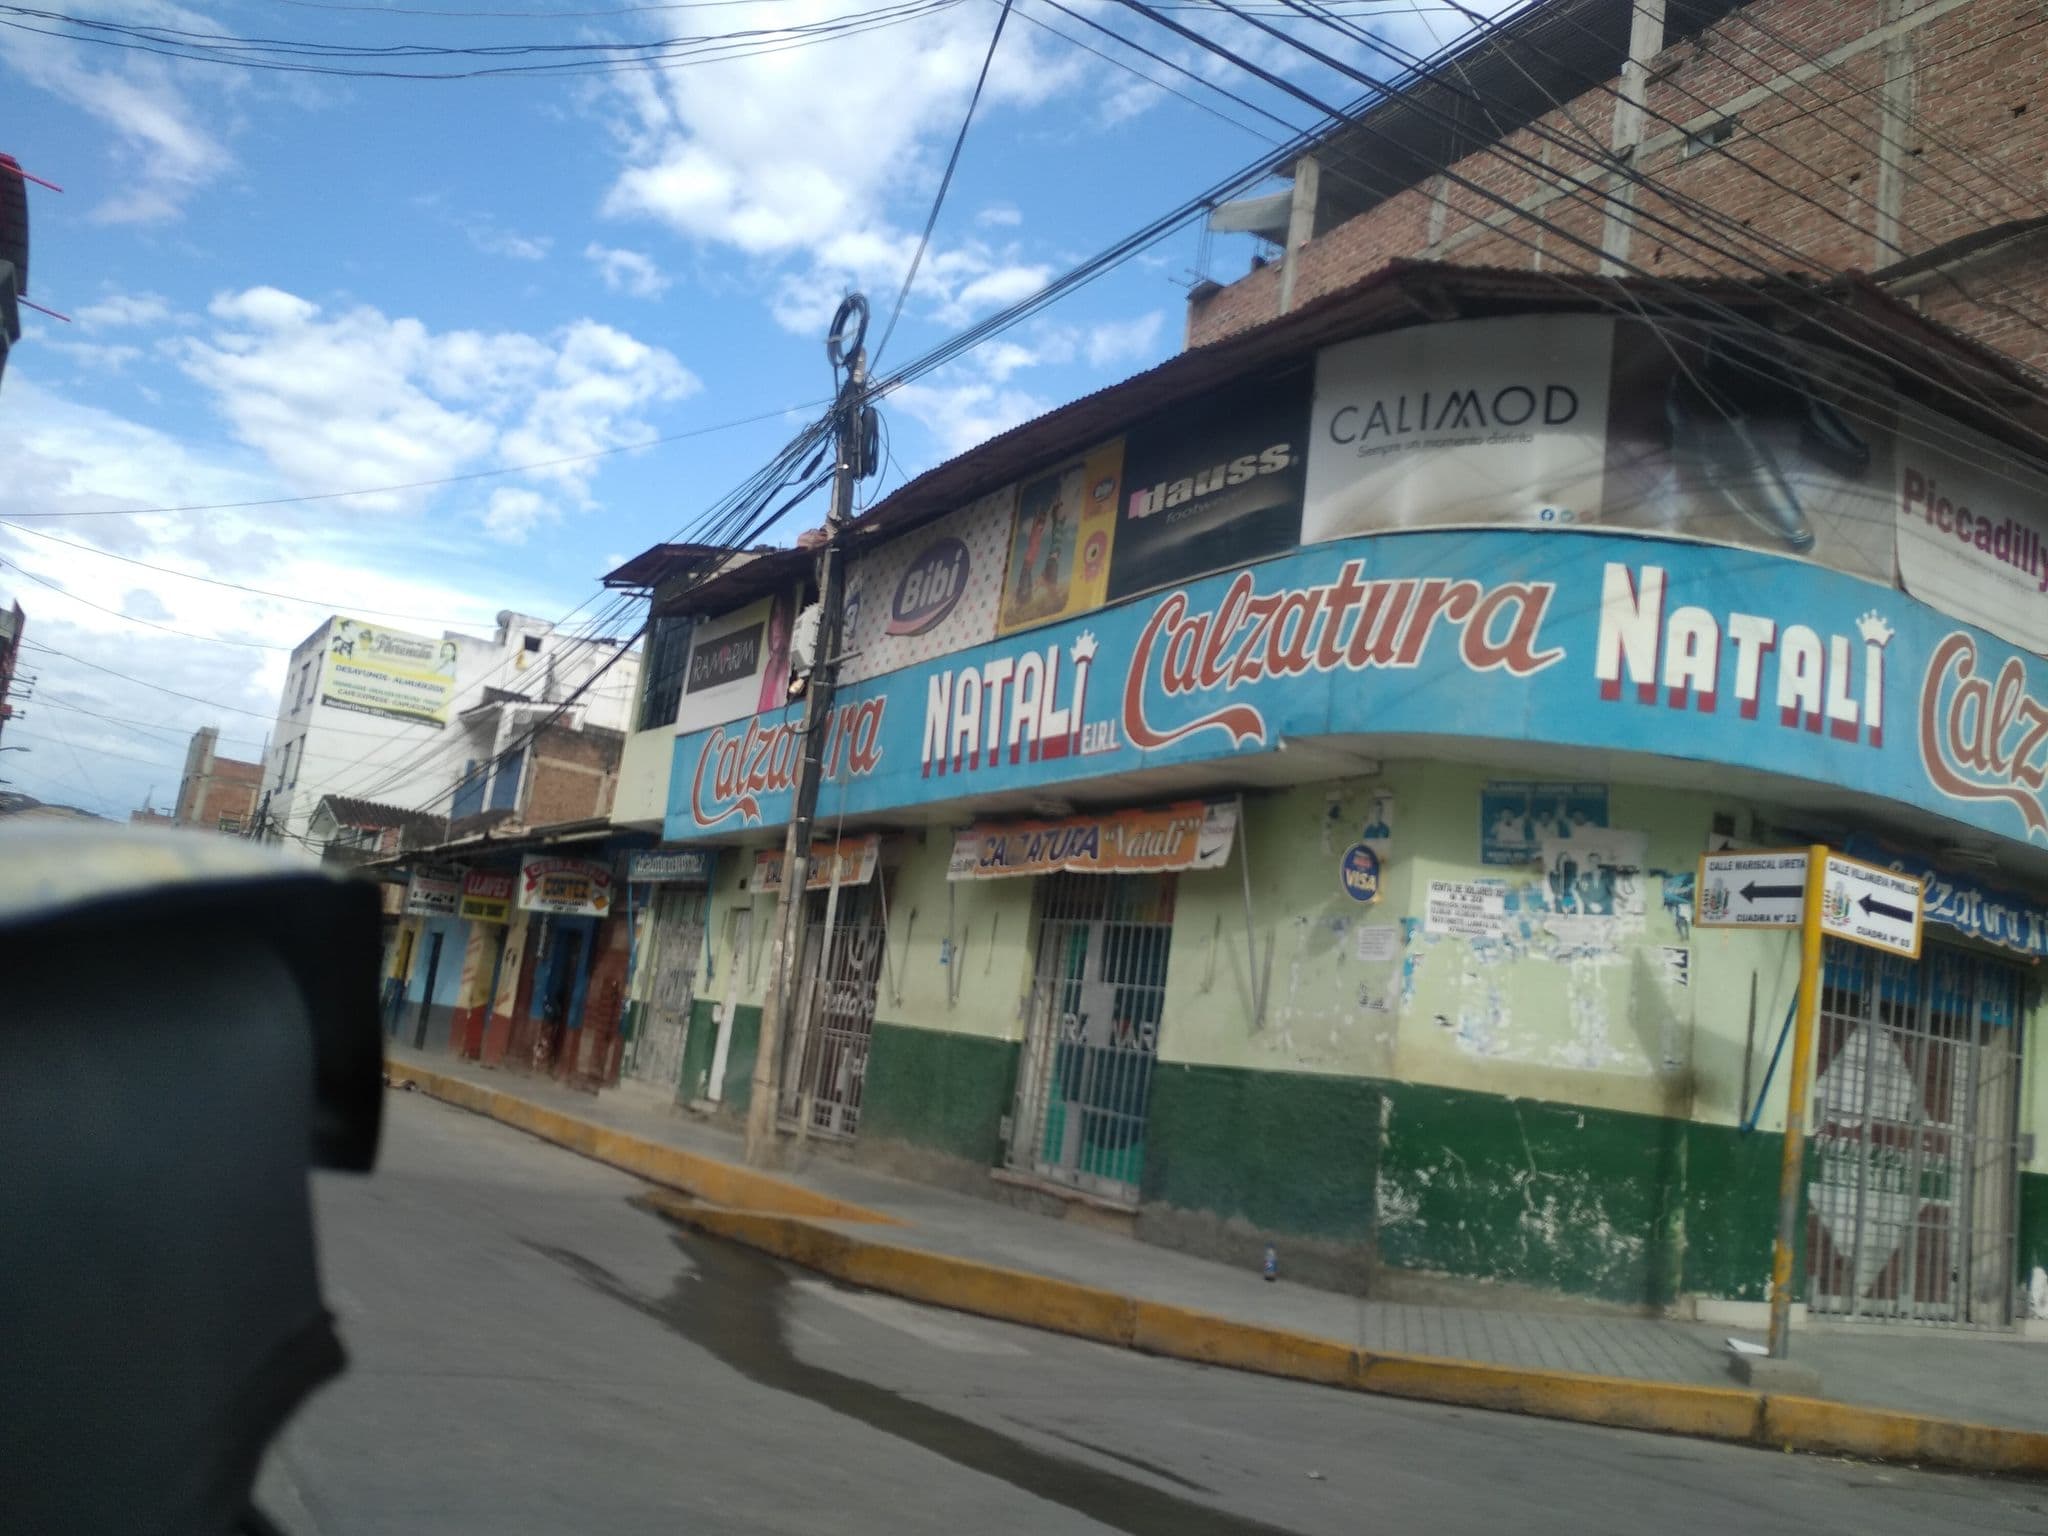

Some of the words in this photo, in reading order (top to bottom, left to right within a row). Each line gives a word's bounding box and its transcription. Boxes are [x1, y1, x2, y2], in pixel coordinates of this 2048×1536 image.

[1329, 384, 1579, 445] CALIMOD
[901, 550, 963, 609] Bibi
[1122, 558, 1567, 752] Calzatura
[692, 695, 888, 829] Calzara
[979, 823, 1099, 868] CAATURA
[1345, 869, 1377, 893] VISA
[1708, 860, 1733, 872] CALLE
[1735, 859, 1777, 871] MARISCAL
[1829, 861, 1850, 876] CALLE
[1736, 913, 1772, 923] CUADRA
[1856, 926, 1888, 941] CUADRA
